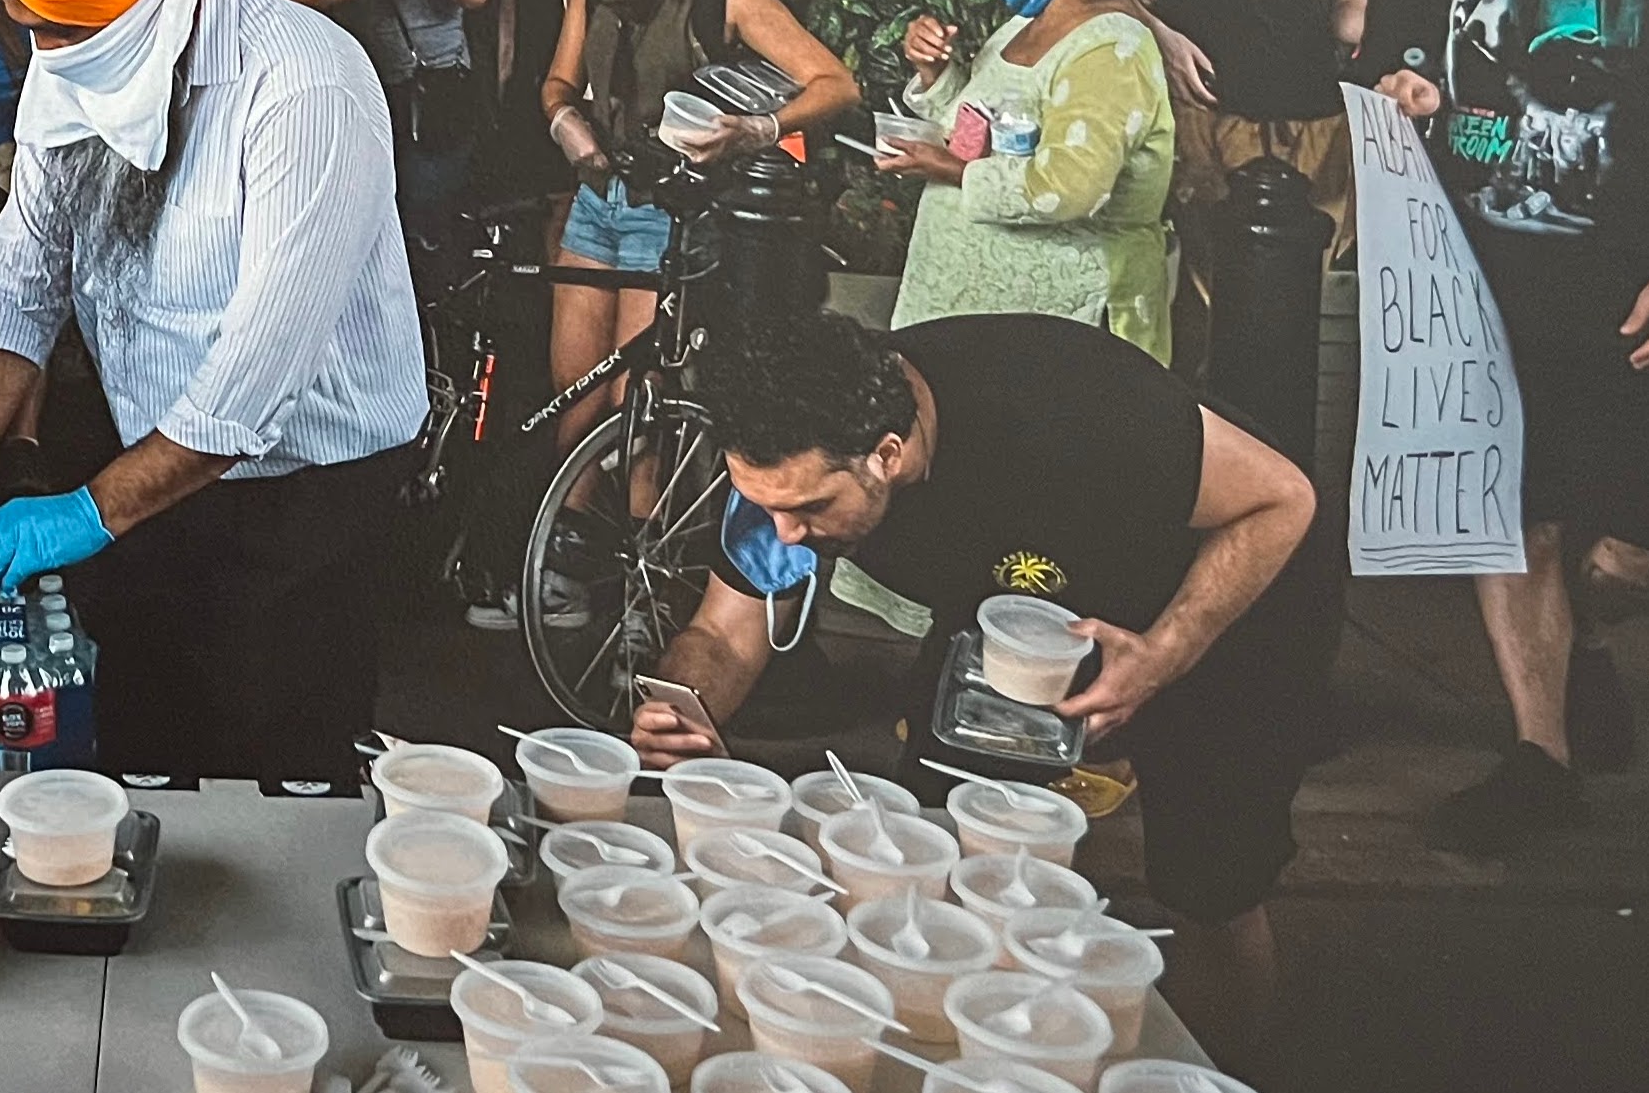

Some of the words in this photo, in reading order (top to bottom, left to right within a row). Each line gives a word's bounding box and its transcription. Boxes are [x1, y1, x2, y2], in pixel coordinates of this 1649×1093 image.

[1451, 135, 1514, 164] ROOM
[1407, 198, 1459, 269] FOR
[1380, 266, 1499, 353] BLACK
[1382, 360, 1504, 429] LIVES
[1361, 444, 1512, 539] MATTER
